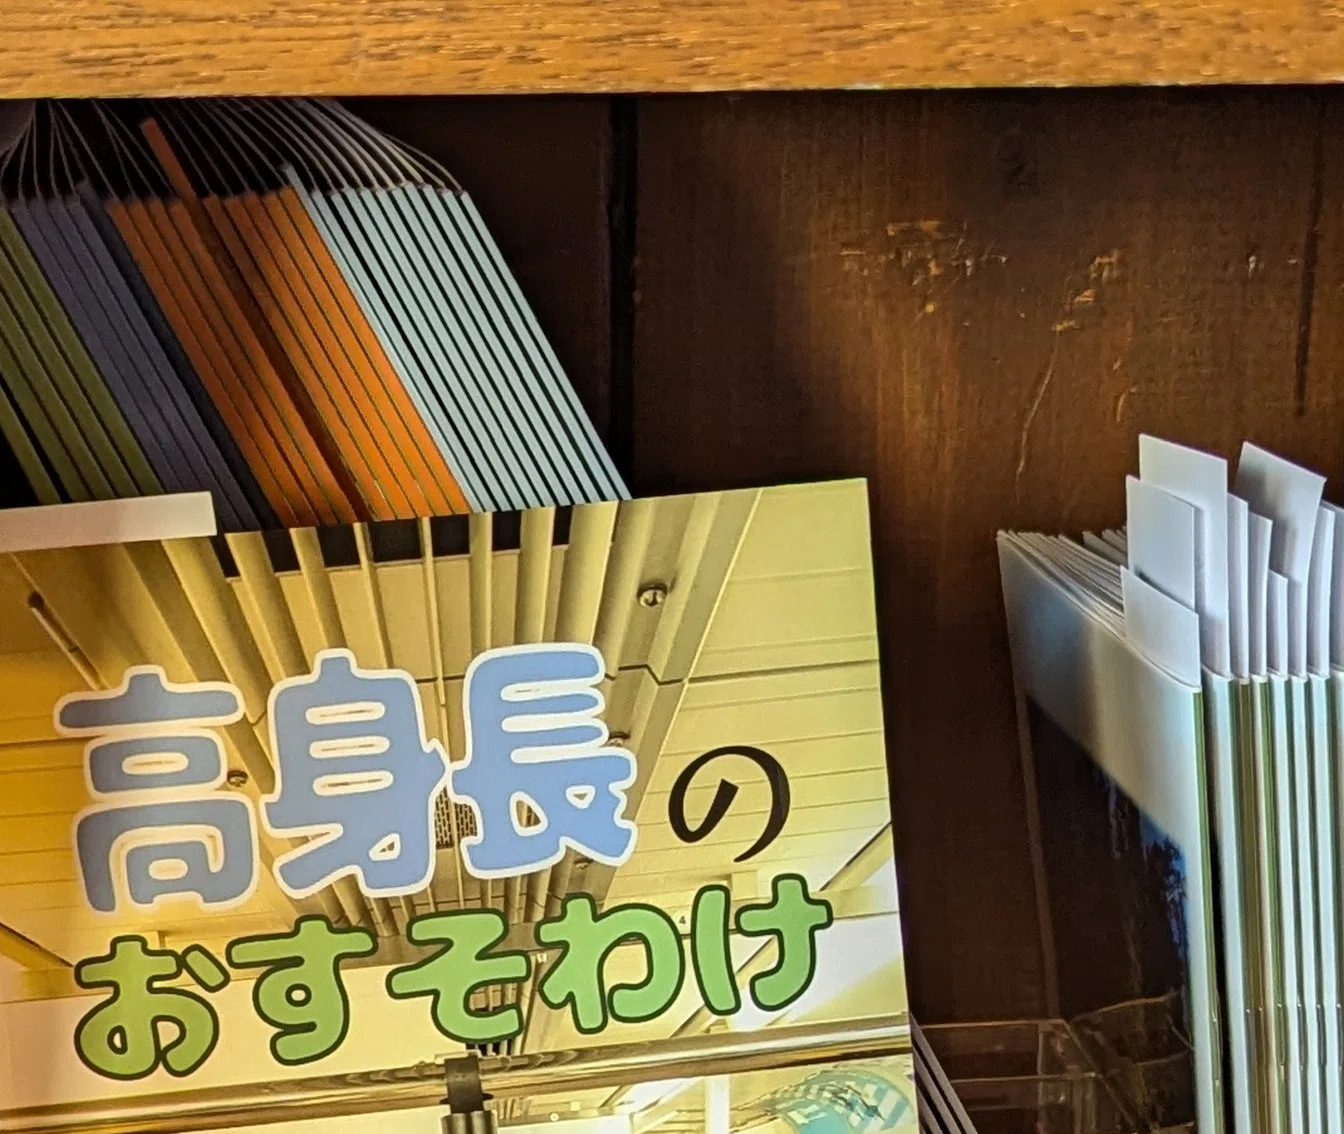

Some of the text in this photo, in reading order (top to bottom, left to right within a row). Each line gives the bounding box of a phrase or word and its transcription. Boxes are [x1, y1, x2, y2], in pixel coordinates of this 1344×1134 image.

[52, 642, 791, 913] 高身長の
[74, 872, 832, 1080] おすそわけ
